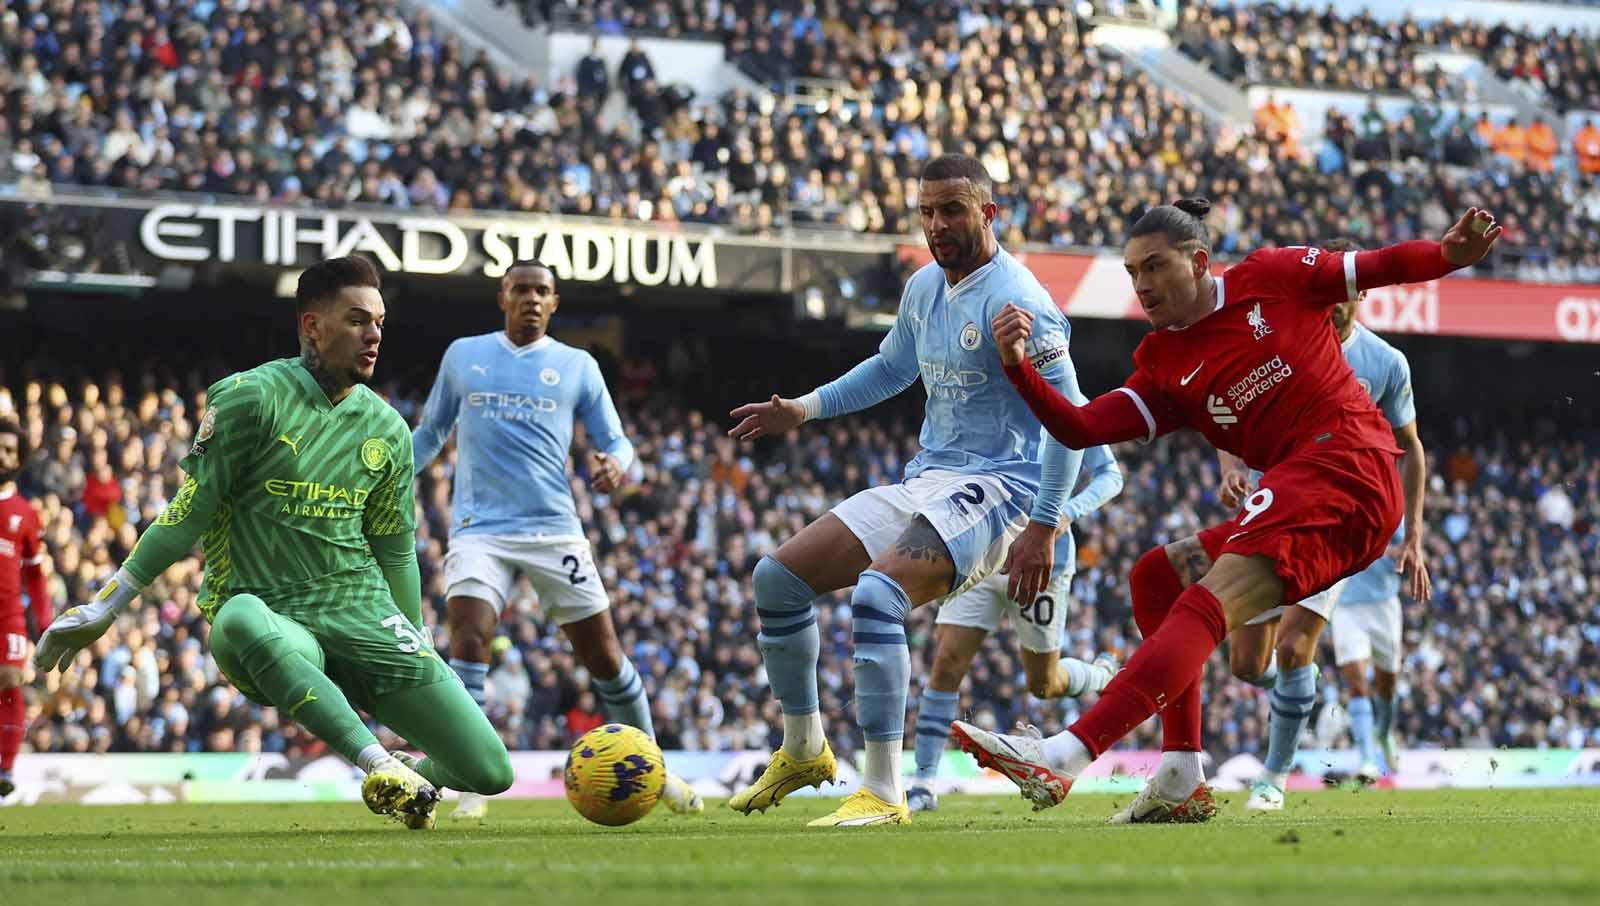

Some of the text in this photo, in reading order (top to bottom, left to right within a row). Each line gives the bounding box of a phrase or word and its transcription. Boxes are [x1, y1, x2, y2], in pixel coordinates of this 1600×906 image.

[141, 203, 717, 288] ETIHAD STADIUM
[1301, 247, 1321, 266] Exp
[919, 360, 988, 387] TIHAD
[1031, 348, 1066, 370] aptain
[1227, 354, 1283, 401] standard
[1235, 364, 1293, 410] chartered
[467, 392, 557, 412] ETIHAD
[265, 480, 368, 505] ETIHAD
[950, 482, 985, 515] 2
[1240, 487, 1274, 526] 9
